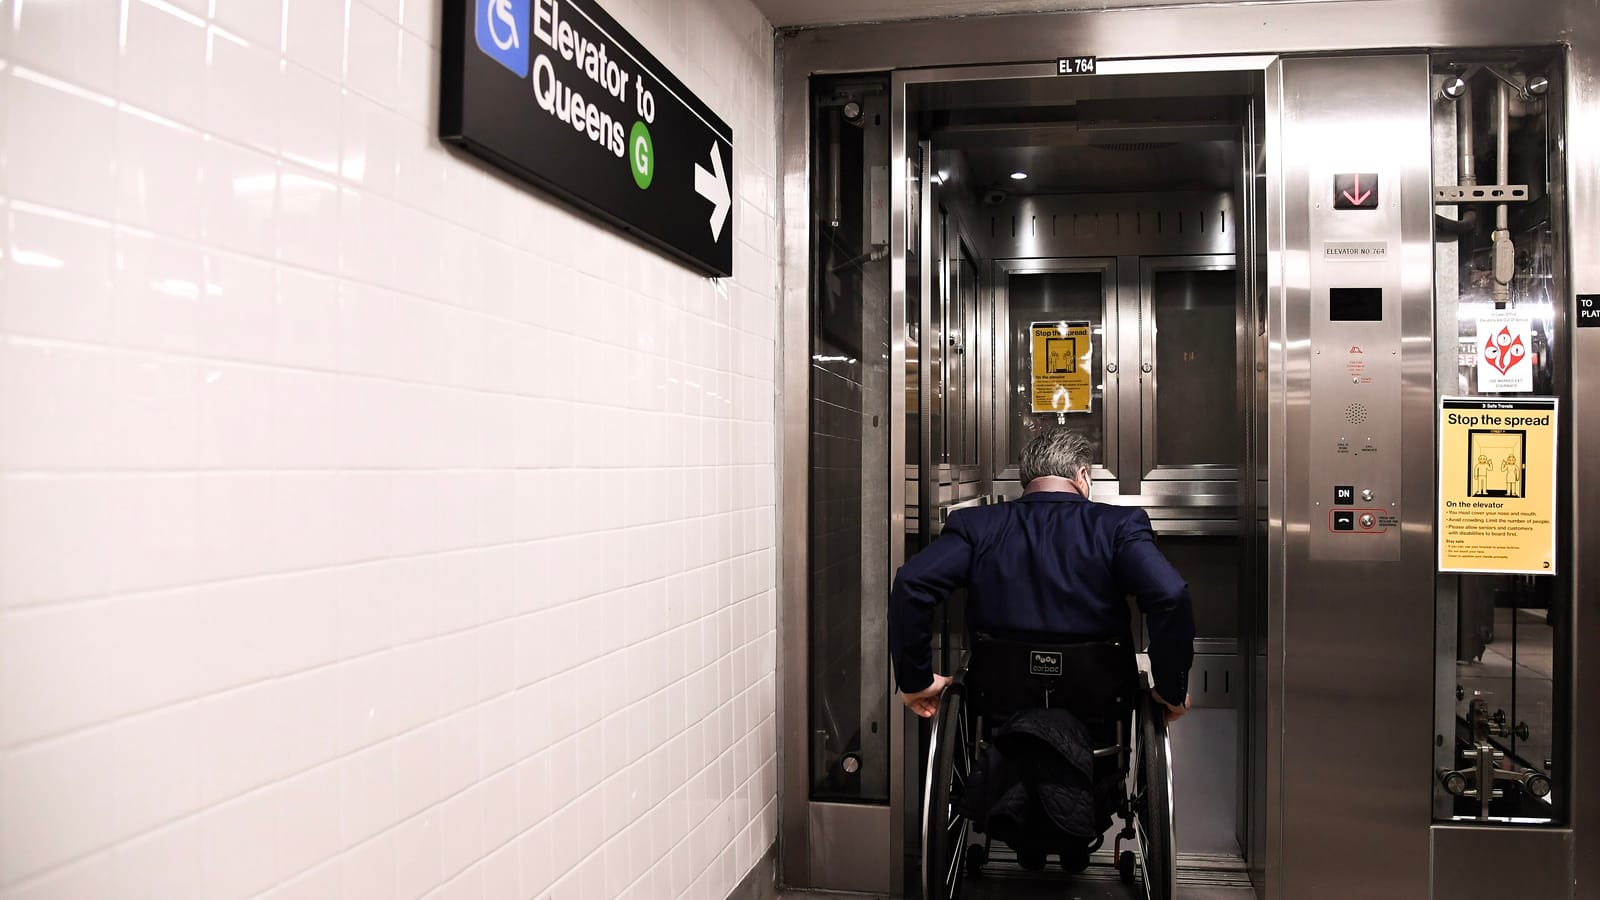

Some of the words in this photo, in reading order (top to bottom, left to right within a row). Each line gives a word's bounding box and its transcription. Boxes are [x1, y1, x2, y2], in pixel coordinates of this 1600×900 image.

[534, 0, 628, 102] Elevator
[636, 74, 655, 123] to
[1060, 59, 1072, 73] EL
[1075, 58, 1094, 72] 764
[533, 54, 625, 157] Queens
[635, 136, 649, 175] G
[1581, 299, 1593, 307] TO
[1581, 310, 1600, 318] PLAT
[1065, 329, 1087, 337] pread
[1448, 413, 1479, 427] Stop
[1481, 414, 1502, 425] the
[1504, 415, 1550, 427] spread
[1338, 489, 1350, 498] DN
[1446, 500, 1457, 508] On
